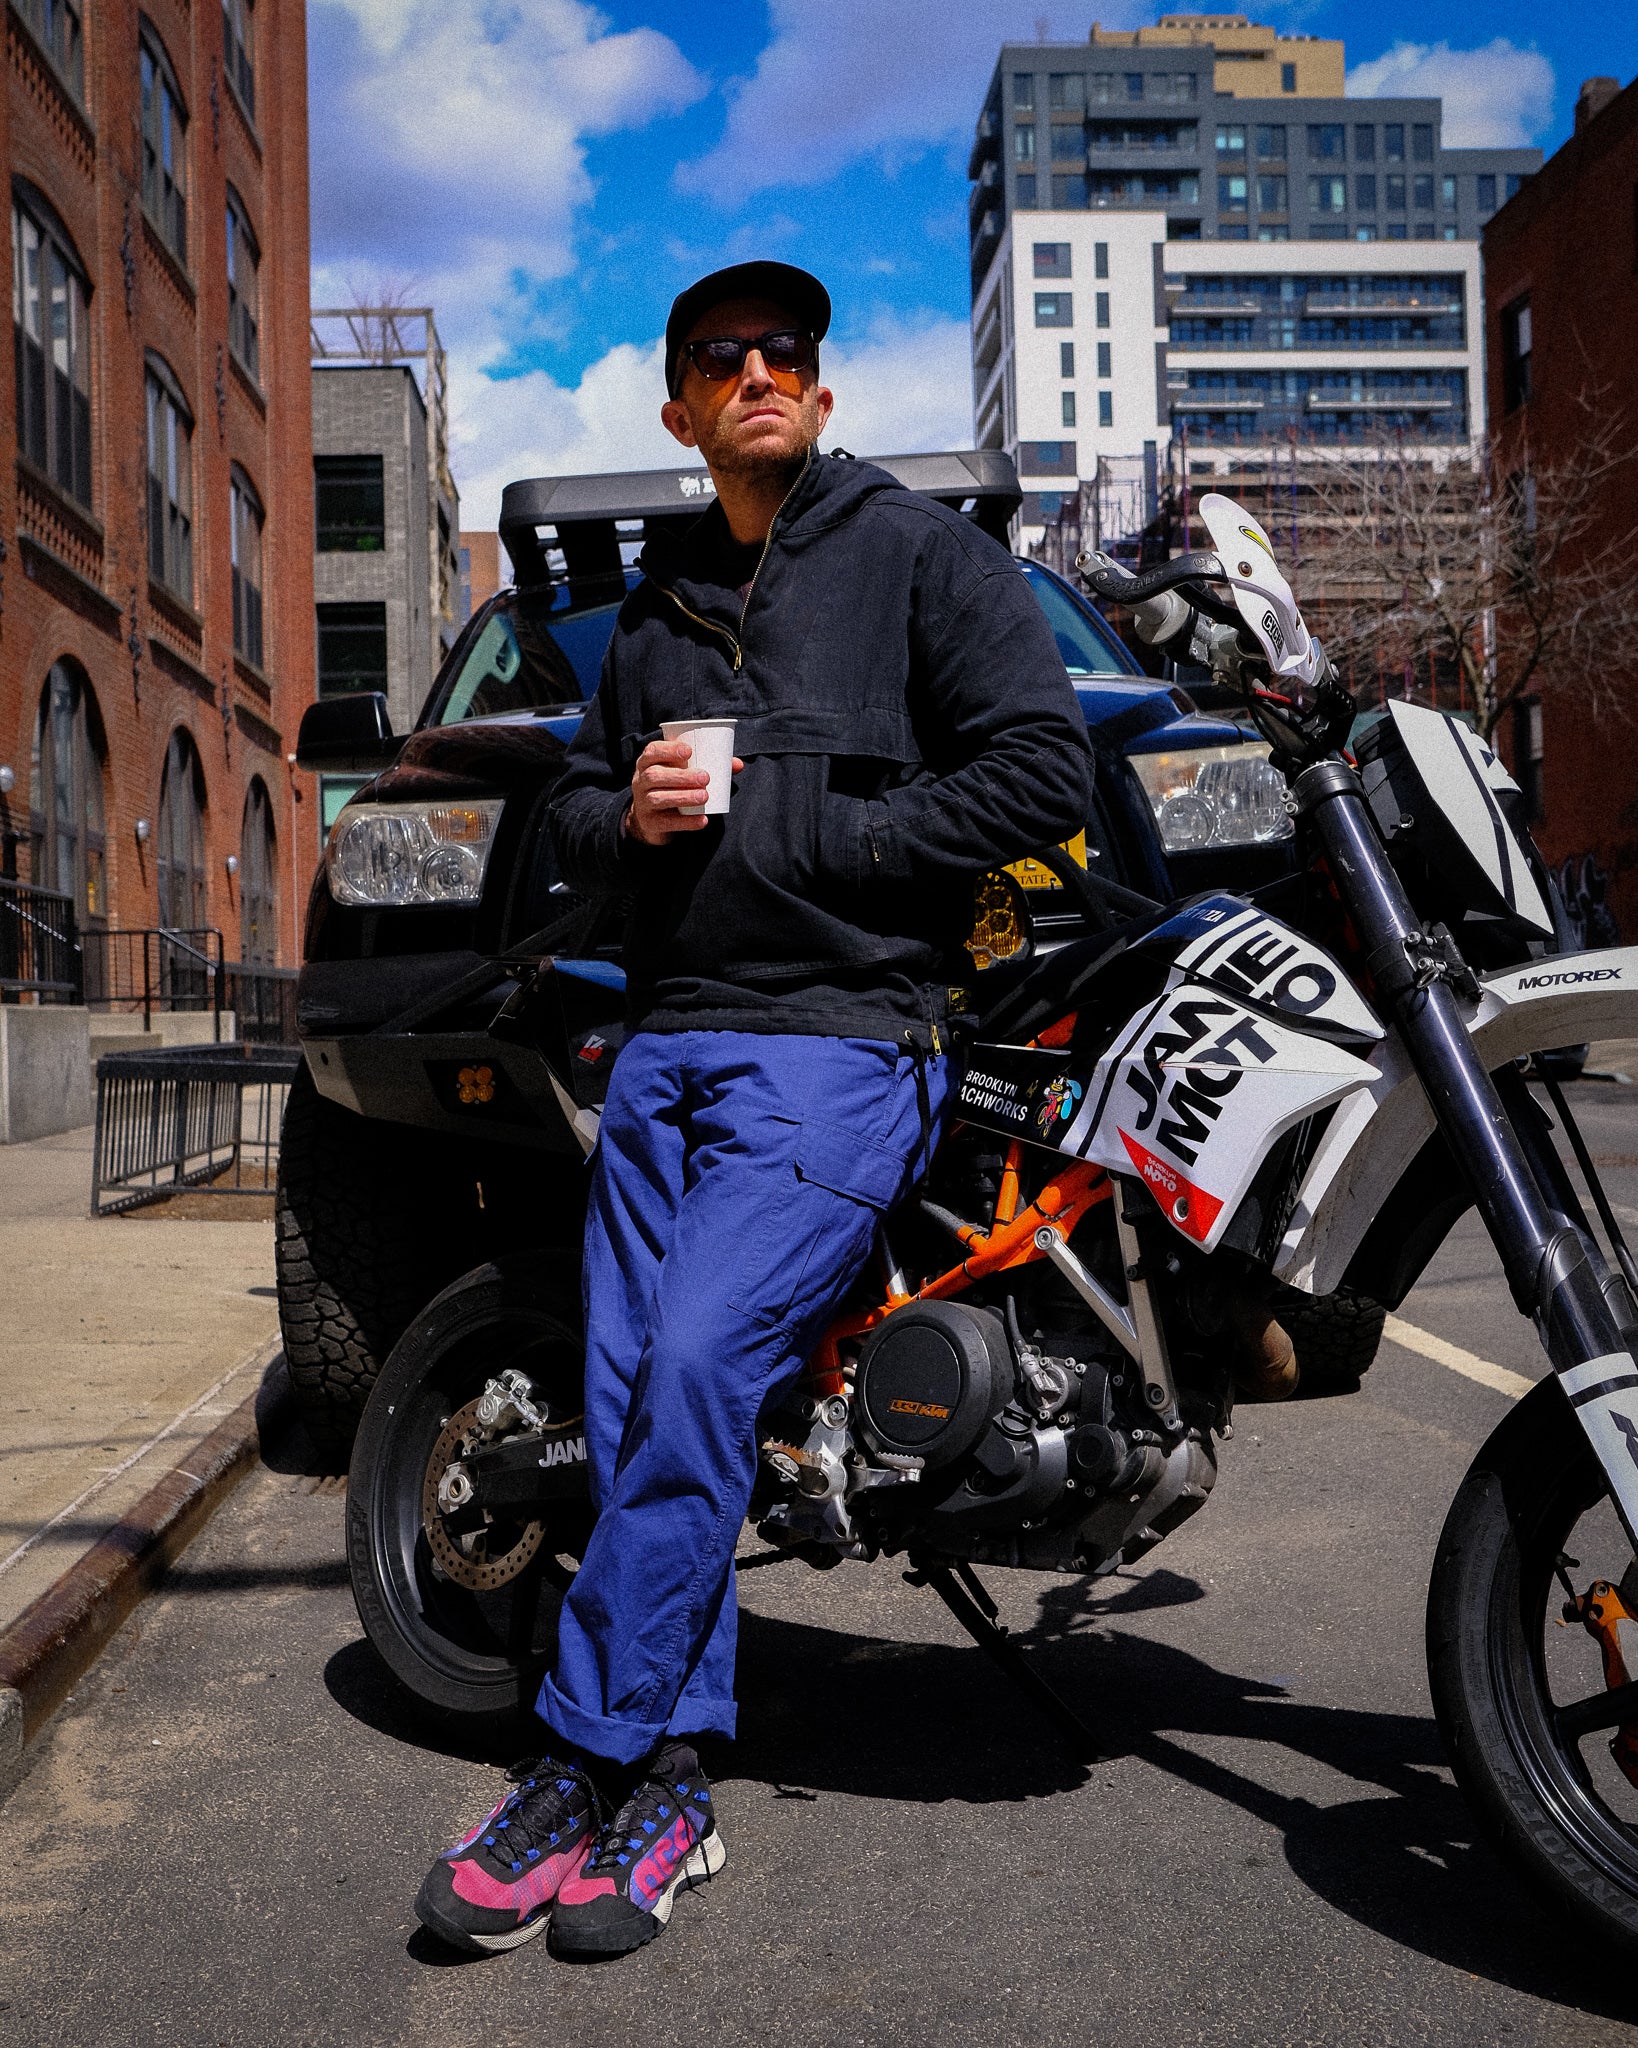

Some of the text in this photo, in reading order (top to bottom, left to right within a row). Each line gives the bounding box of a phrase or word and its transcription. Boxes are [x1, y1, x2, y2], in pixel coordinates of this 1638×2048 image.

[1017, 874, 1047, 886] TATE
[1517, 967, 1623, 991] MOTOREX
[1126, 930, 1300, 1131] JANE
[1155, 963, 1336, 1168] MOTO
[965, 1069, 1018, 1098] BROOKLYN
[919, 1404, 949, 1419] KTM
